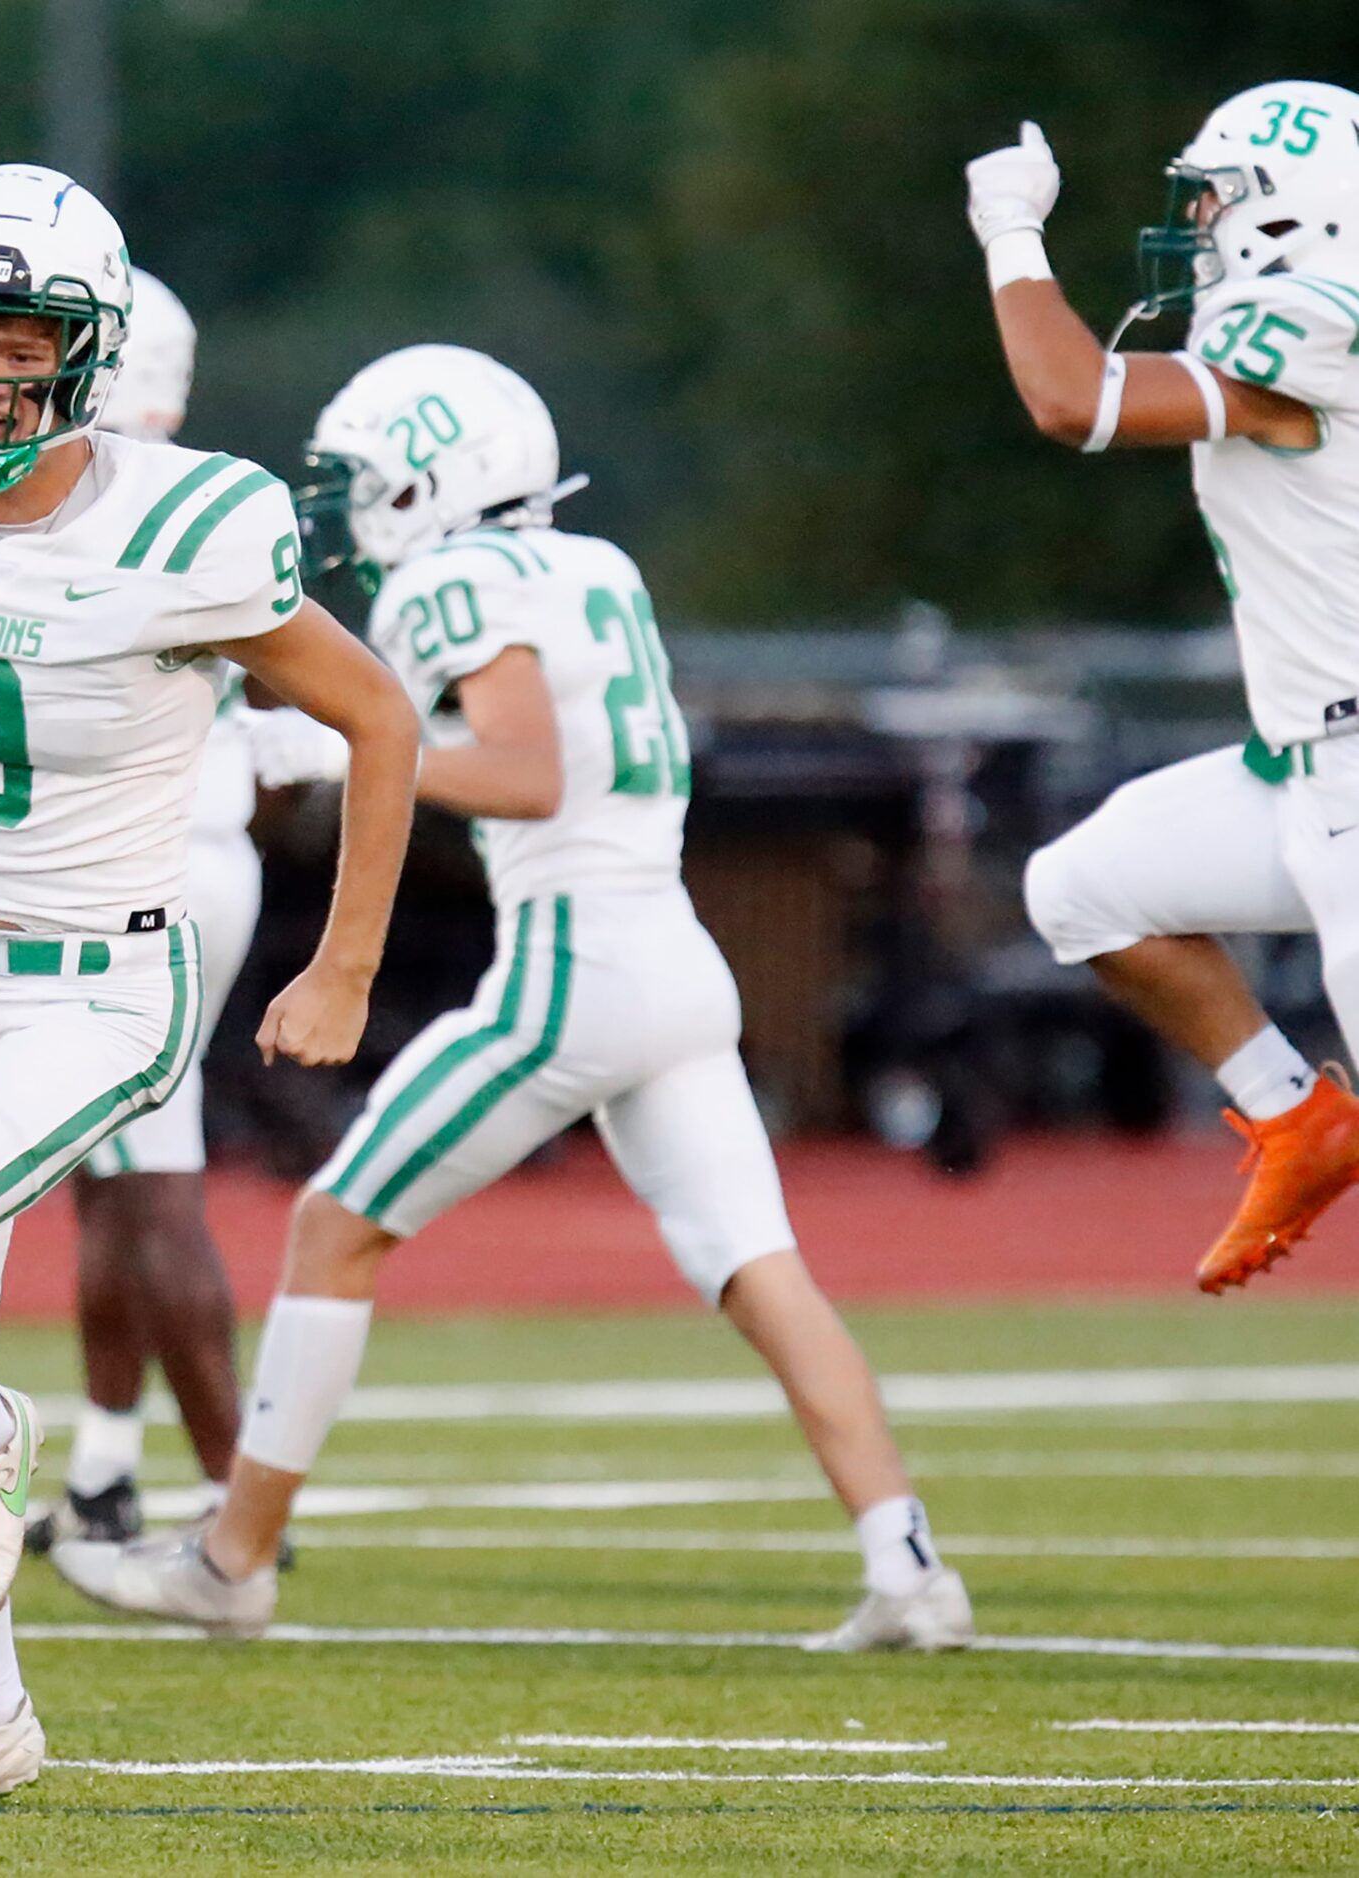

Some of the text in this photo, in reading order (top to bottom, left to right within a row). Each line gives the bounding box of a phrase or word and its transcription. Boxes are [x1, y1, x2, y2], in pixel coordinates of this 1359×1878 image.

[1249, 101, 1331, 156] 35
[1201, 302, 1308, 385] 35
[386, 394, 461, 470] 20
[271, 530, 301, 616] 9
[399, 579, 482, 662] 20
[141, 914, 155, 928] M
